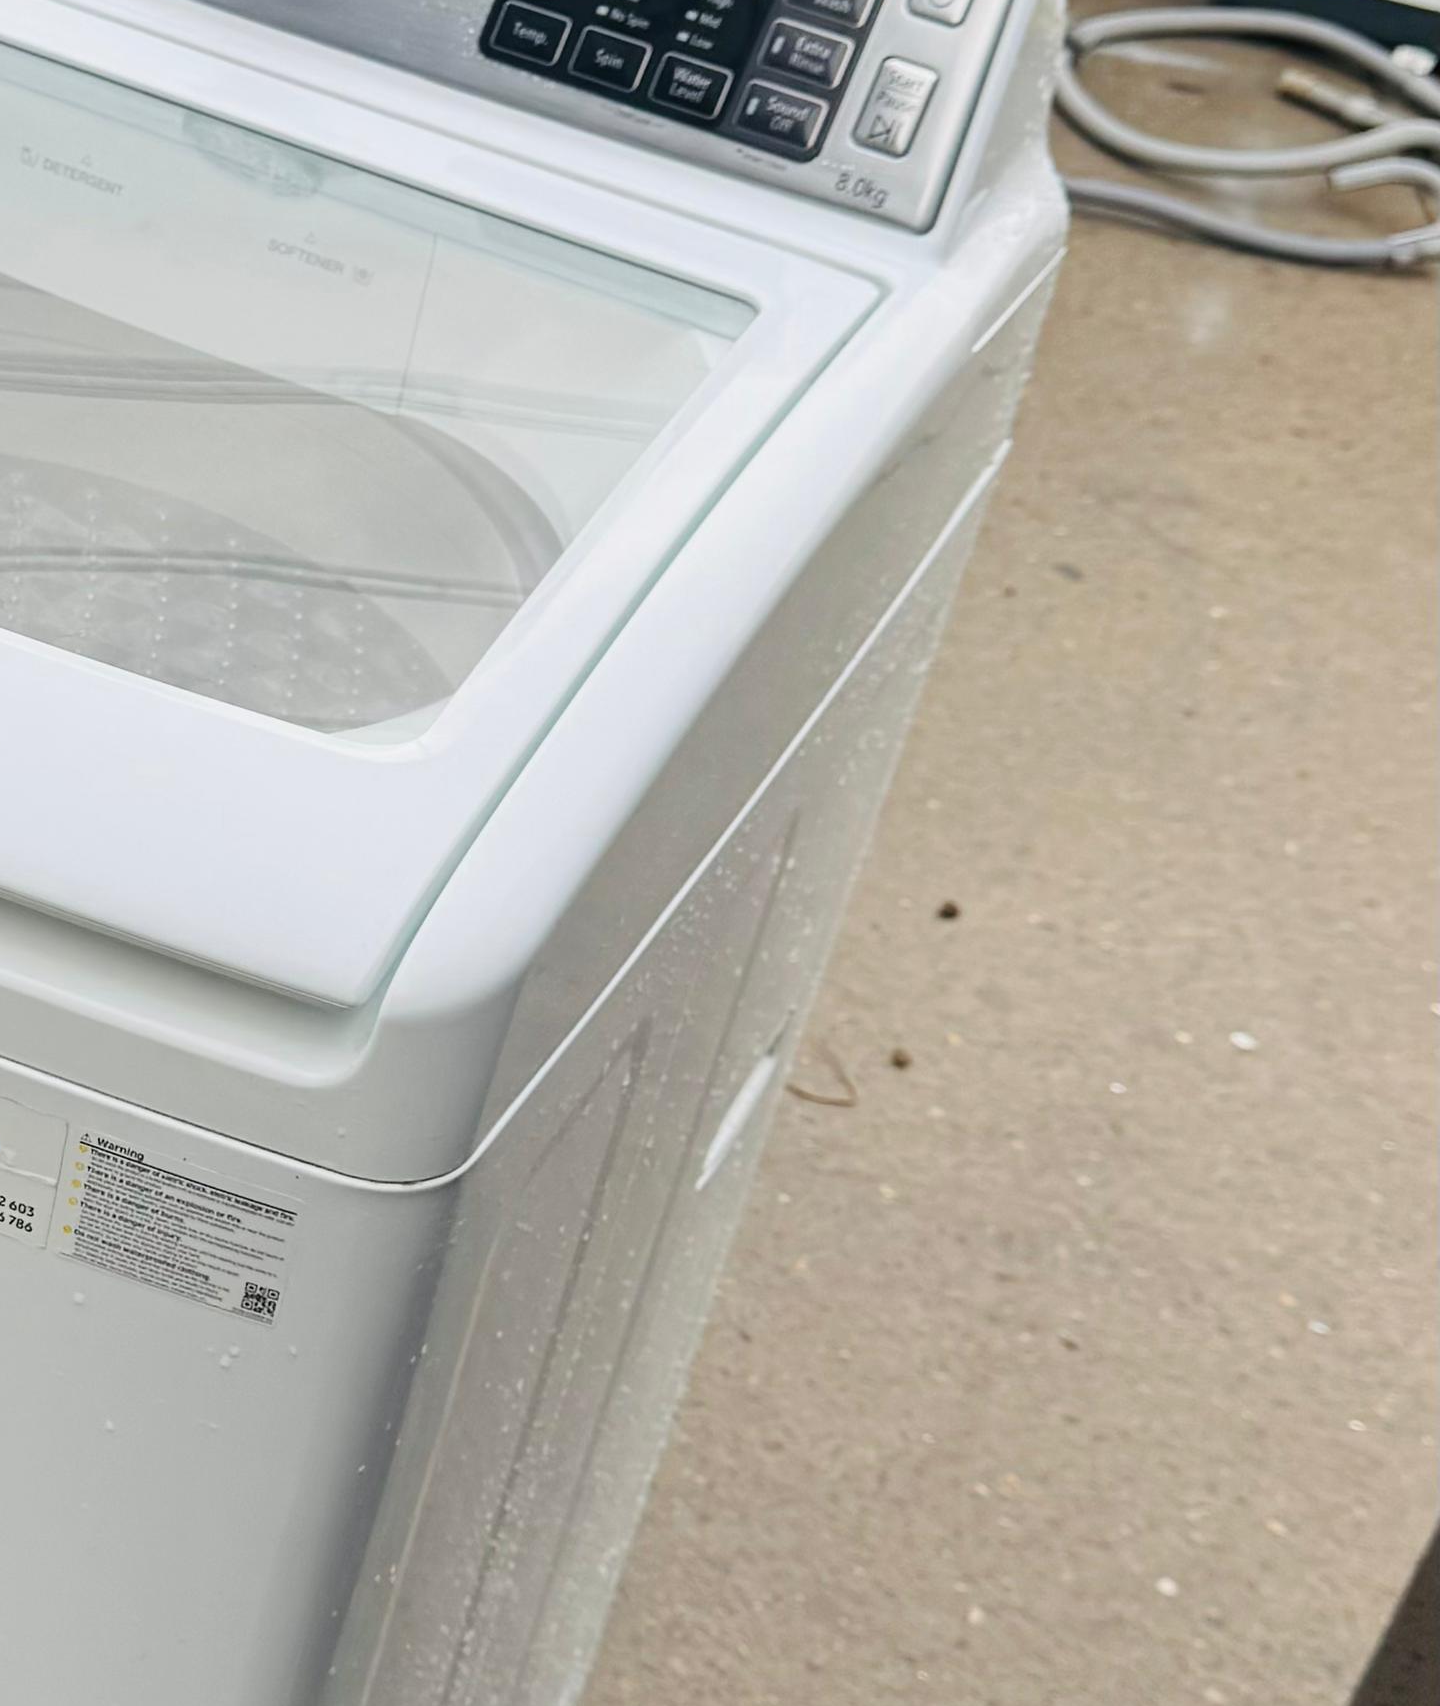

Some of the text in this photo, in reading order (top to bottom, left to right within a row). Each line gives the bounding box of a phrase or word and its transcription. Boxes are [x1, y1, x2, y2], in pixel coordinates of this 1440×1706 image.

[594, 48, 624, 70] Spin
[766, 97, 810, 121] Sound
[835, 172, 889, 208] 8.0kg
[97, 1136, 145, 1161] Warning
[83, 1183, 105, 1196] There
[121, 1196, 149, 1212] danger
[86, 1166, 108, 1179] There
[125, 1178, 153, 1195] danger
[164, 1192, 174, 1201] an
[175, 1195, 215, 1215] explosion
[9, 1200, 35, 1218] 603
[79, 1200, 102, 1214] There
[118, 1213, 145, 1230] danger
[8, 1214, 33, 1233] 786
